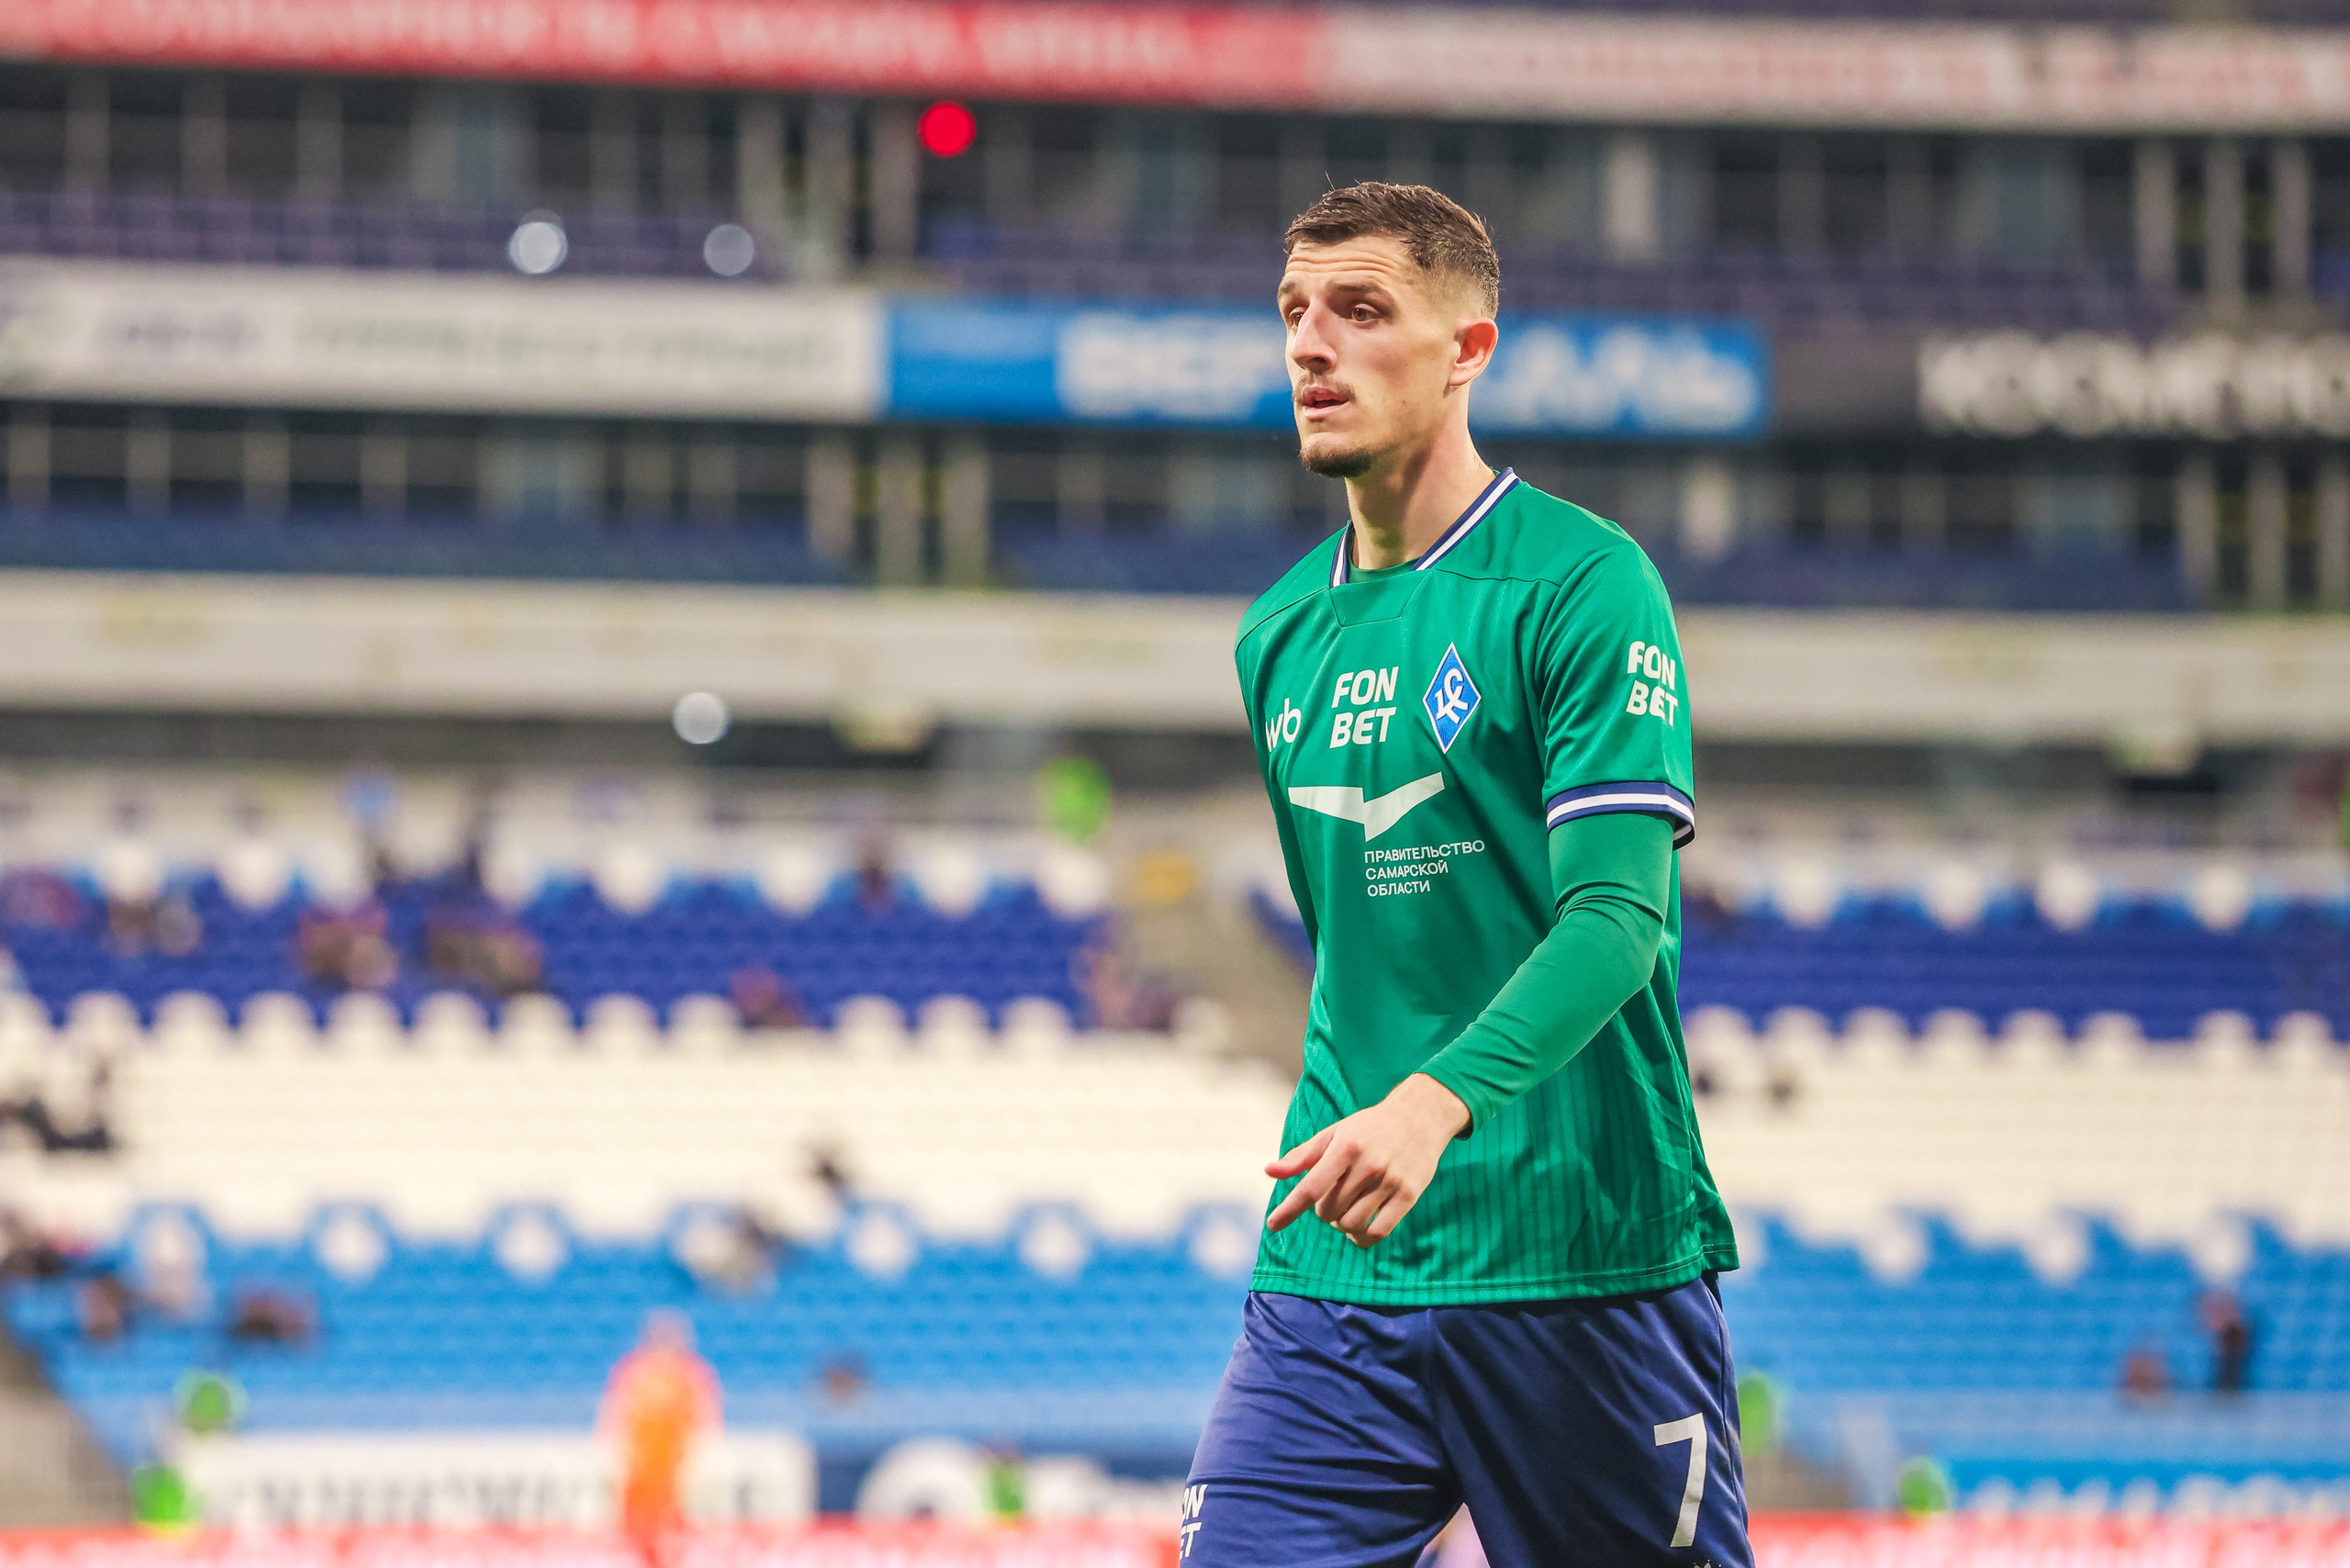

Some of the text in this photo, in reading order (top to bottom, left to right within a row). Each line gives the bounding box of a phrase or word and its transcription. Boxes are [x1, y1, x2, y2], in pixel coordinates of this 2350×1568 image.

[1331, 666, 1399, 709] FON
[1627, 641, 1676, 691] FON
[1626, 680, 1678, 727] BET
[1265, 698, 1302, 753] wb
[1329, 706, 1397, 749] BET
[1364, 840, 1485, 864] ПРАВИТЕЛЬСТВО
[1365, 859, 1449, 880] САМАРСКОЙ
[1367, 879, 1431, 897] ОБЛАСТИ
[1653, 1412, 1708, 1548] 7
[1180, 1521, 1203, 1561] ET
